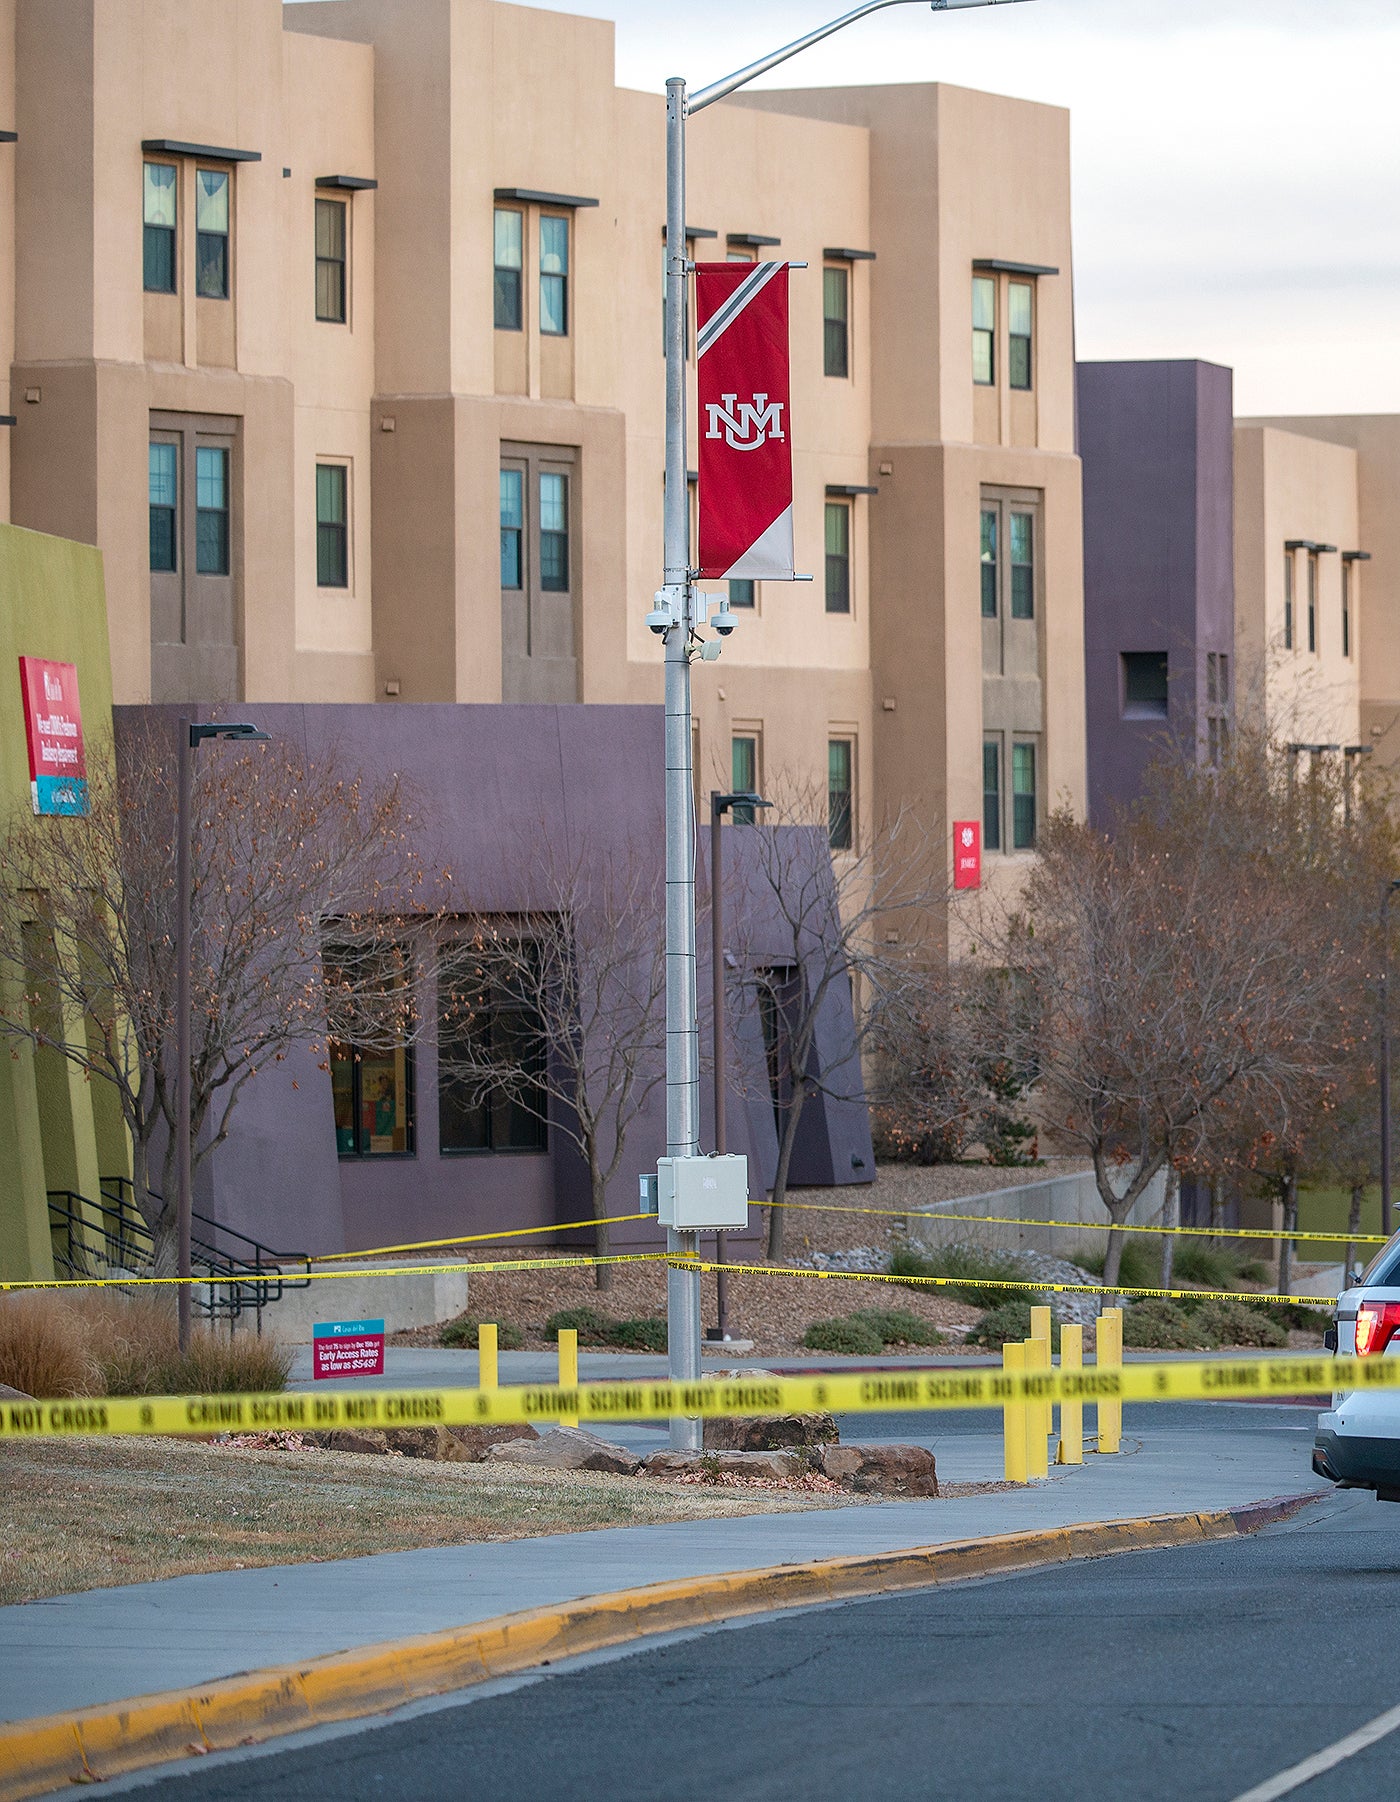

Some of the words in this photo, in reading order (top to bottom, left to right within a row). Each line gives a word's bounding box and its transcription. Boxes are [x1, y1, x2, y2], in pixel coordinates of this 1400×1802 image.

[704, 393, 785, 451] UNM
[319, 1350, 336, 1362] Early
[336, 1350, 359, 1360] Access
[360, 1348, 379, 1358] Rates
[321, 1363, 329, 1371] as
[330, 1361, 343, 1371] low
[343, 1361, 351, 1370] as
[352, 1358, 377, 1369] $549!
[723, 1384, 780, 1408] CROSS
[1063, 1372, 1120, 1396] CROSS
[10, 1404, 43, 1431] NOT
[50, 1403, 108, 1431] CROSS
[383, 1396, 444, 1420] CROSS
